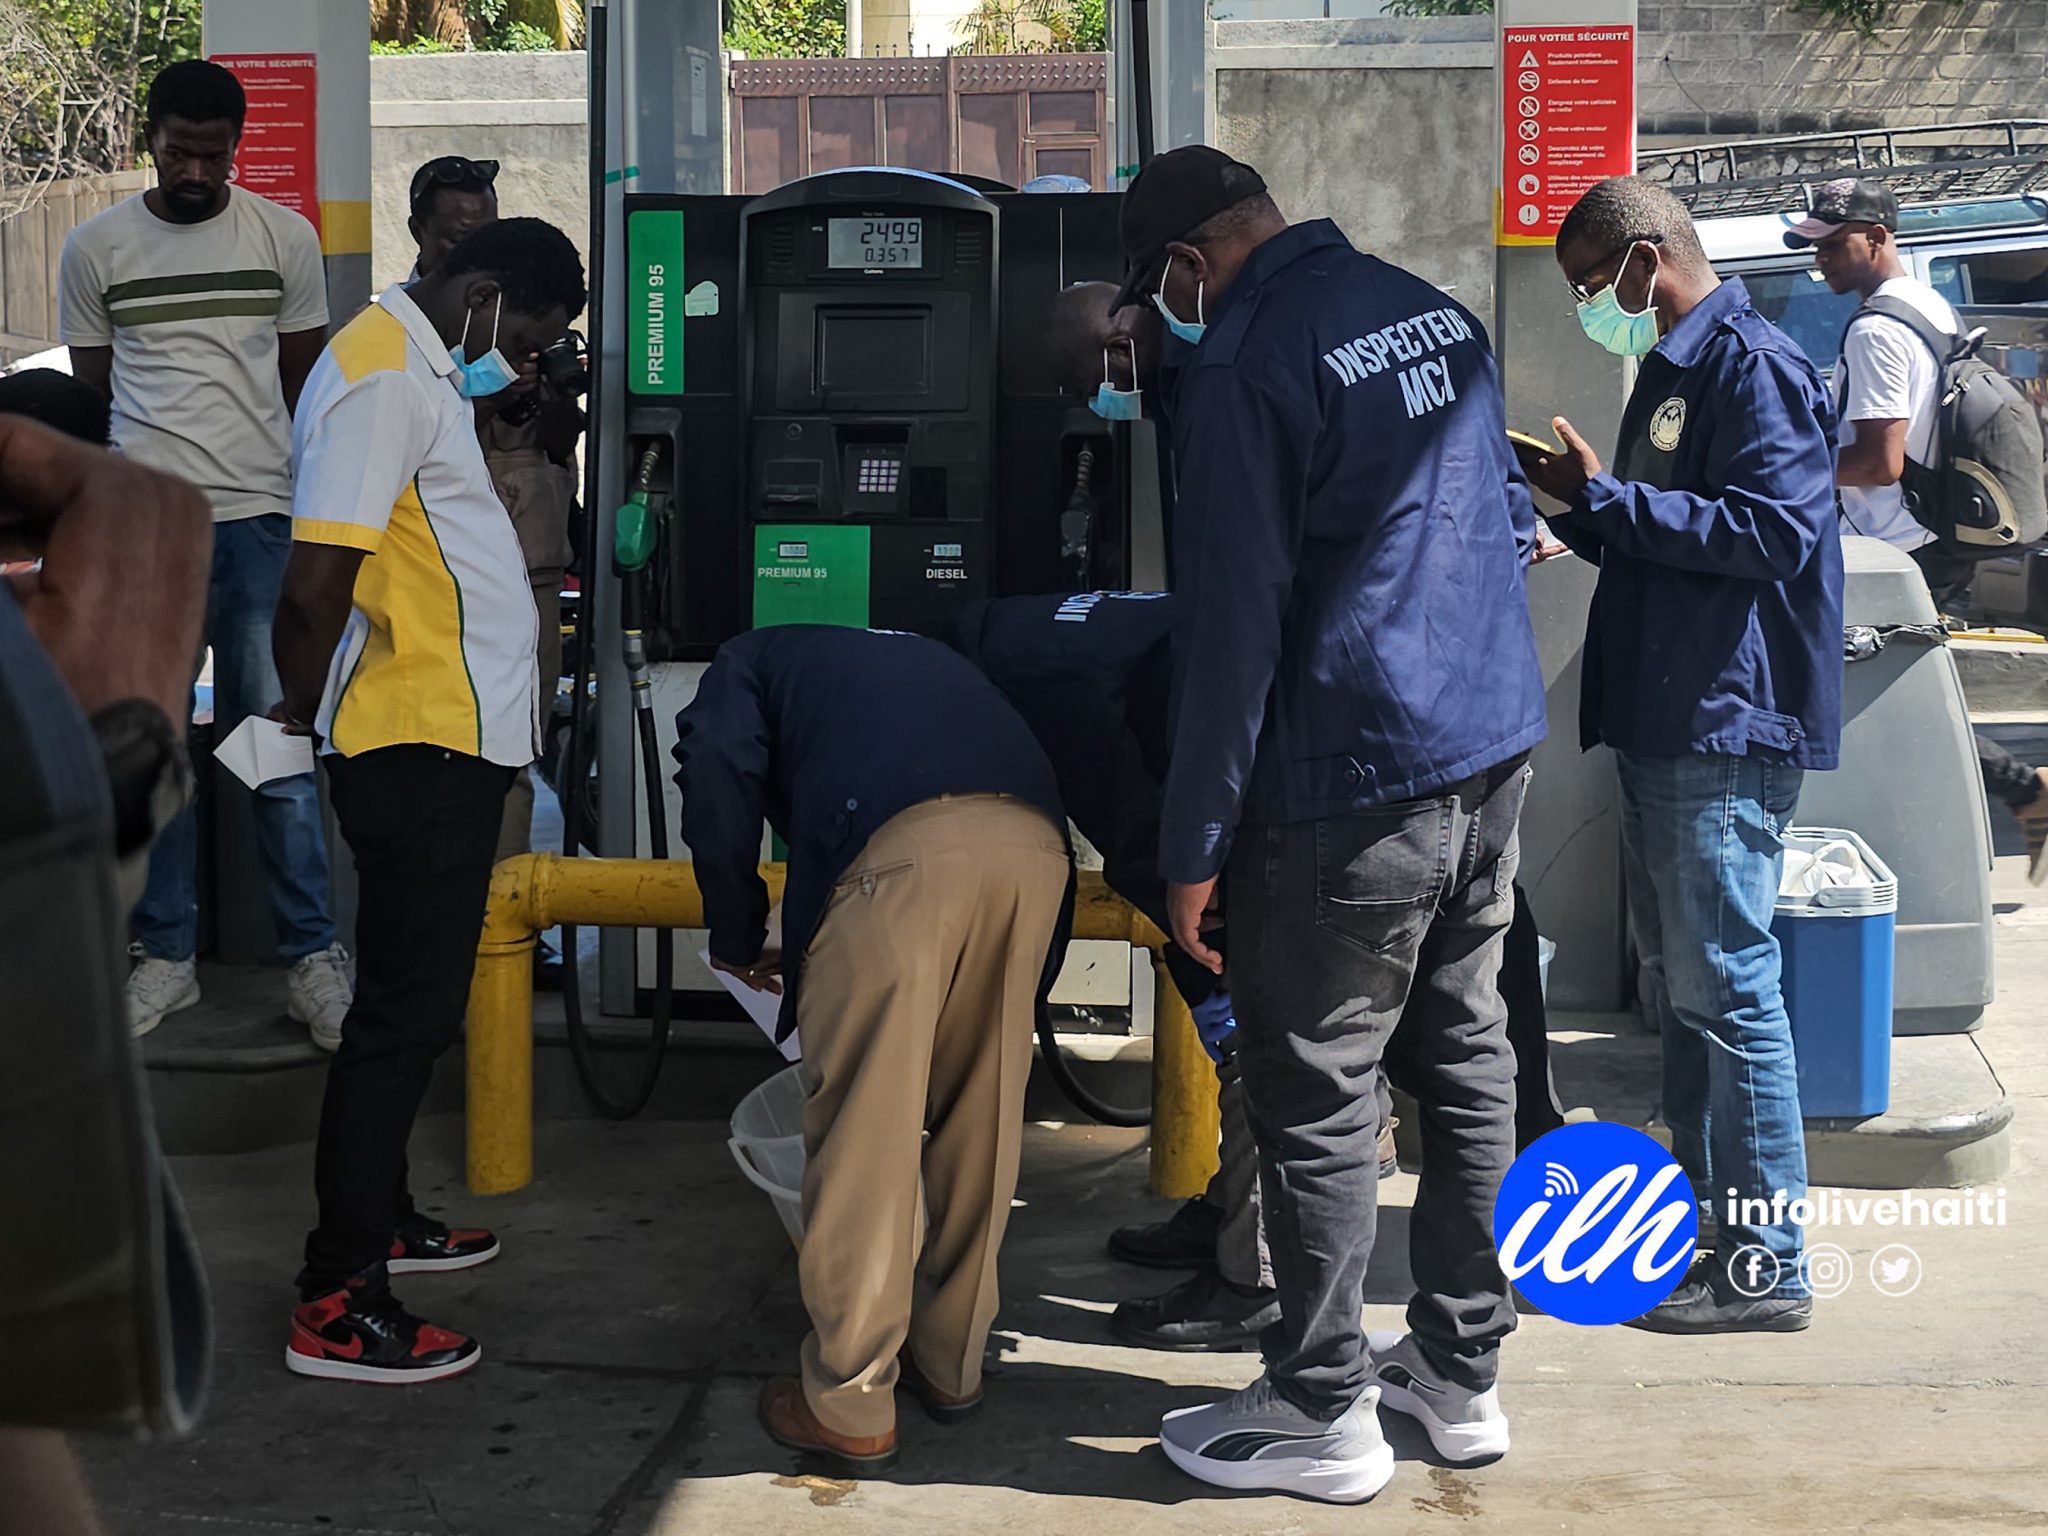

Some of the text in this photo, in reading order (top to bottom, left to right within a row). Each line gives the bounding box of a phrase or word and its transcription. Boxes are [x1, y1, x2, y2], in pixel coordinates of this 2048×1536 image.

[1507, 32, 1629, 43] POUR VOTRE SÉCURITÉ
[860, 222, 919, 244] 249.9
[865, 247, 908, 263] 0.357
[647, 264, 664, 385] PREMIUM 95
[1397, 355, 1457, 419] MCI
[757, 567, 827, 578] PREMIUM 95
[926, 568, 969, 579] DIESEL
